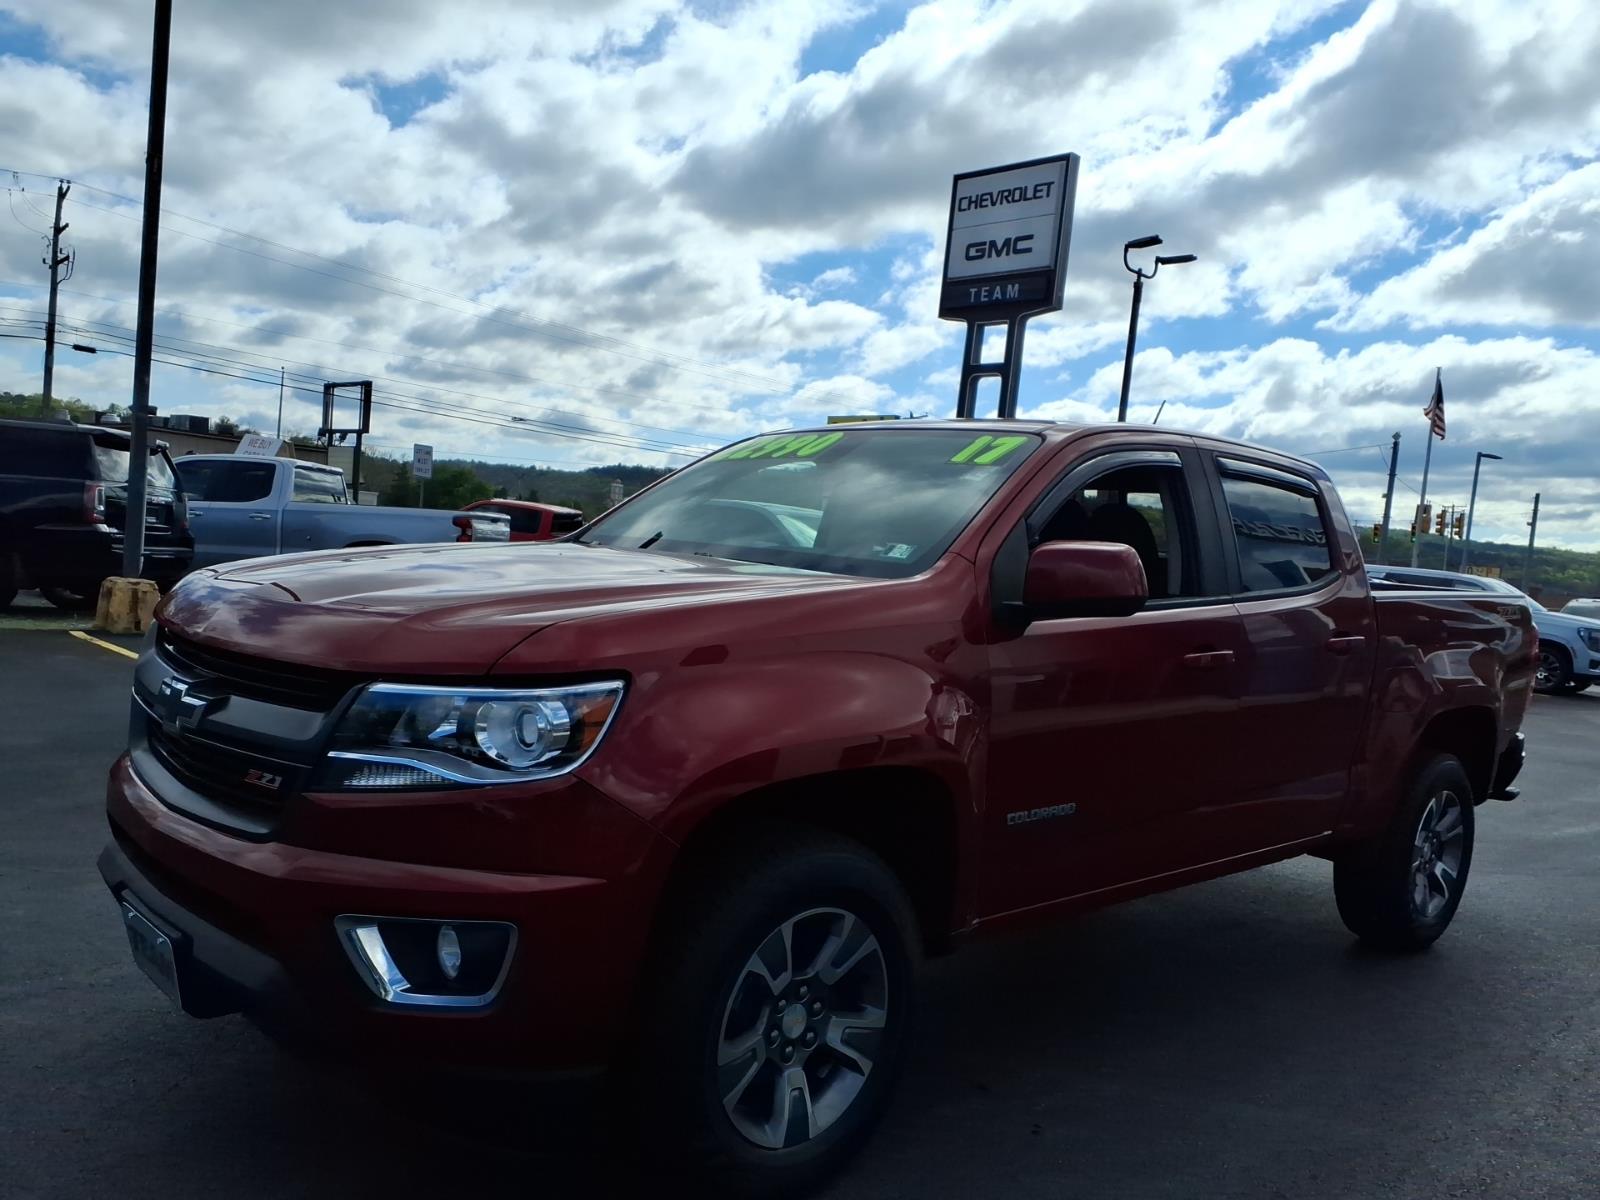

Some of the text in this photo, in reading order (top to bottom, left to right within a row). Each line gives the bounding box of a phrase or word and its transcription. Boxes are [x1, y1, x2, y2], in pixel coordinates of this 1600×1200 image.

[958, 181, 1055, 212] CHEVROLET
[965, 234, 1034, 262] GMC
[969, 283, 1020, 303] TEAM
[949, 435, 1029, 465] 17
[243, 768, 283, 790] Z71
[1006, 802, 1077, 824] COLORADO
